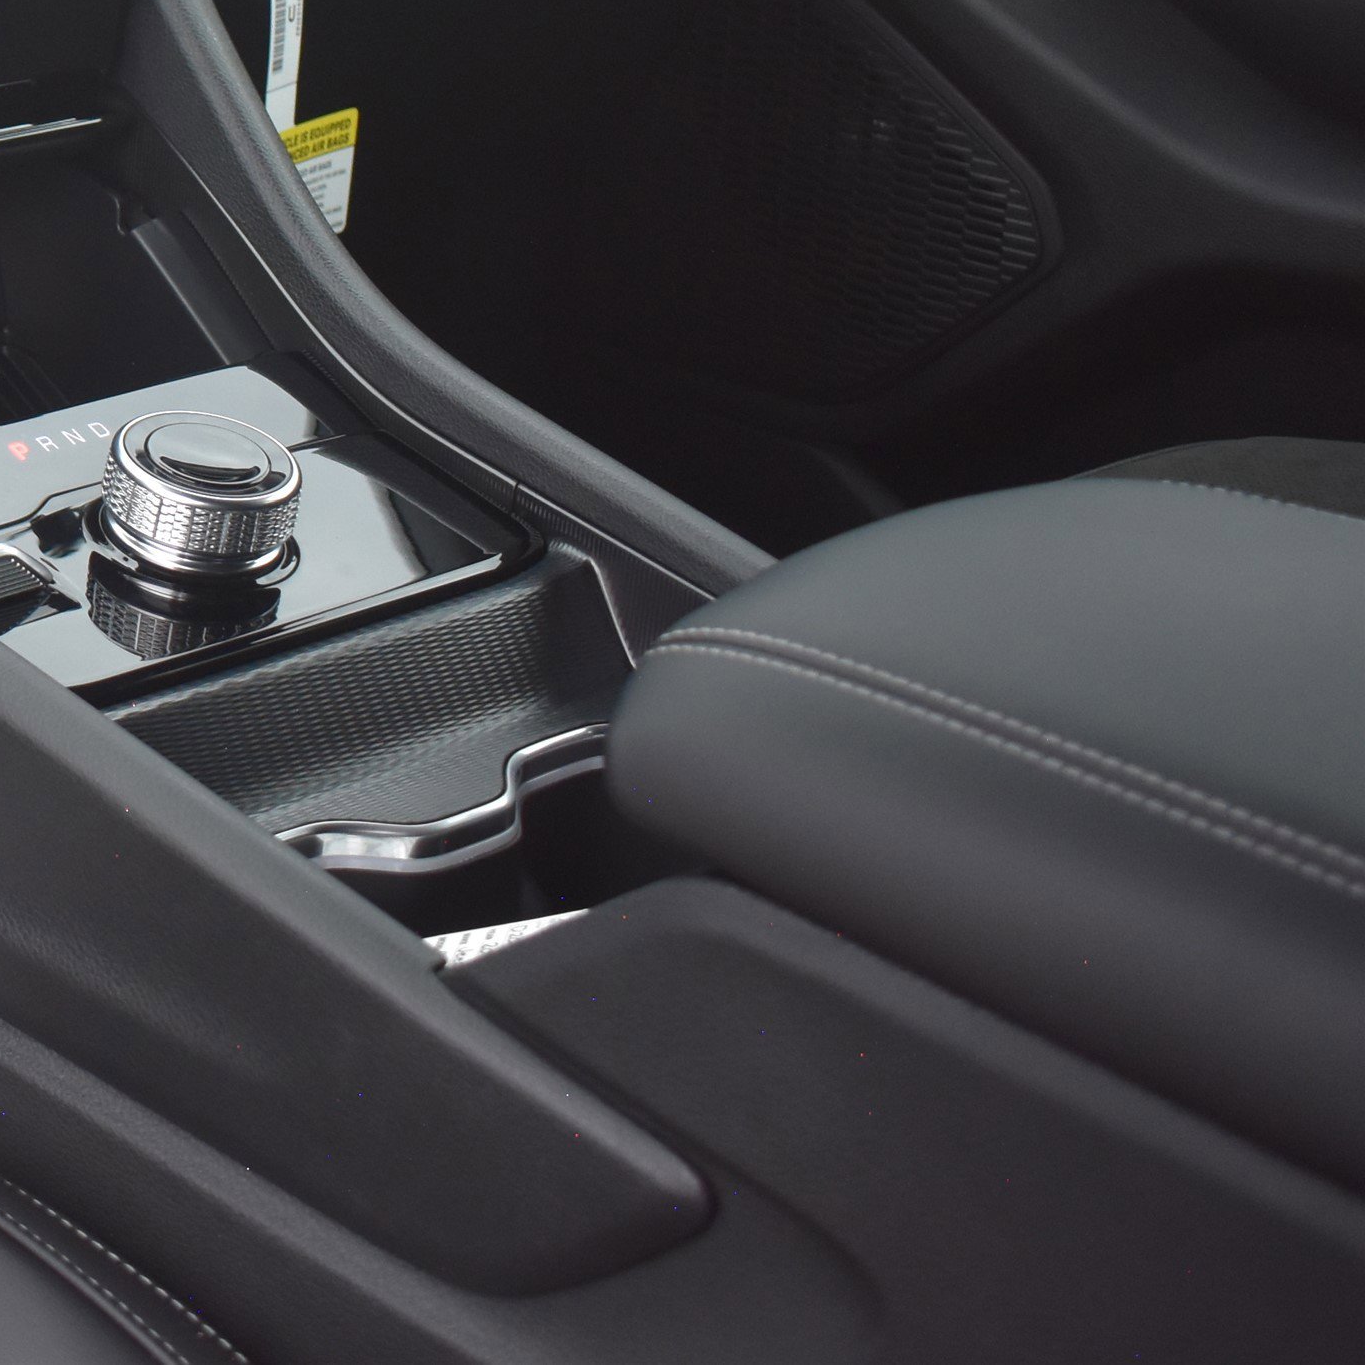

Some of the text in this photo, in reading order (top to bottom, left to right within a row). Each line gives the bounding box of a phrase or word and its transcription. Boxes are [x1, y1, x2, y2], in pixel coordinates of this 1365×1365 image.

[9, 422, 112, 461] P R N D
